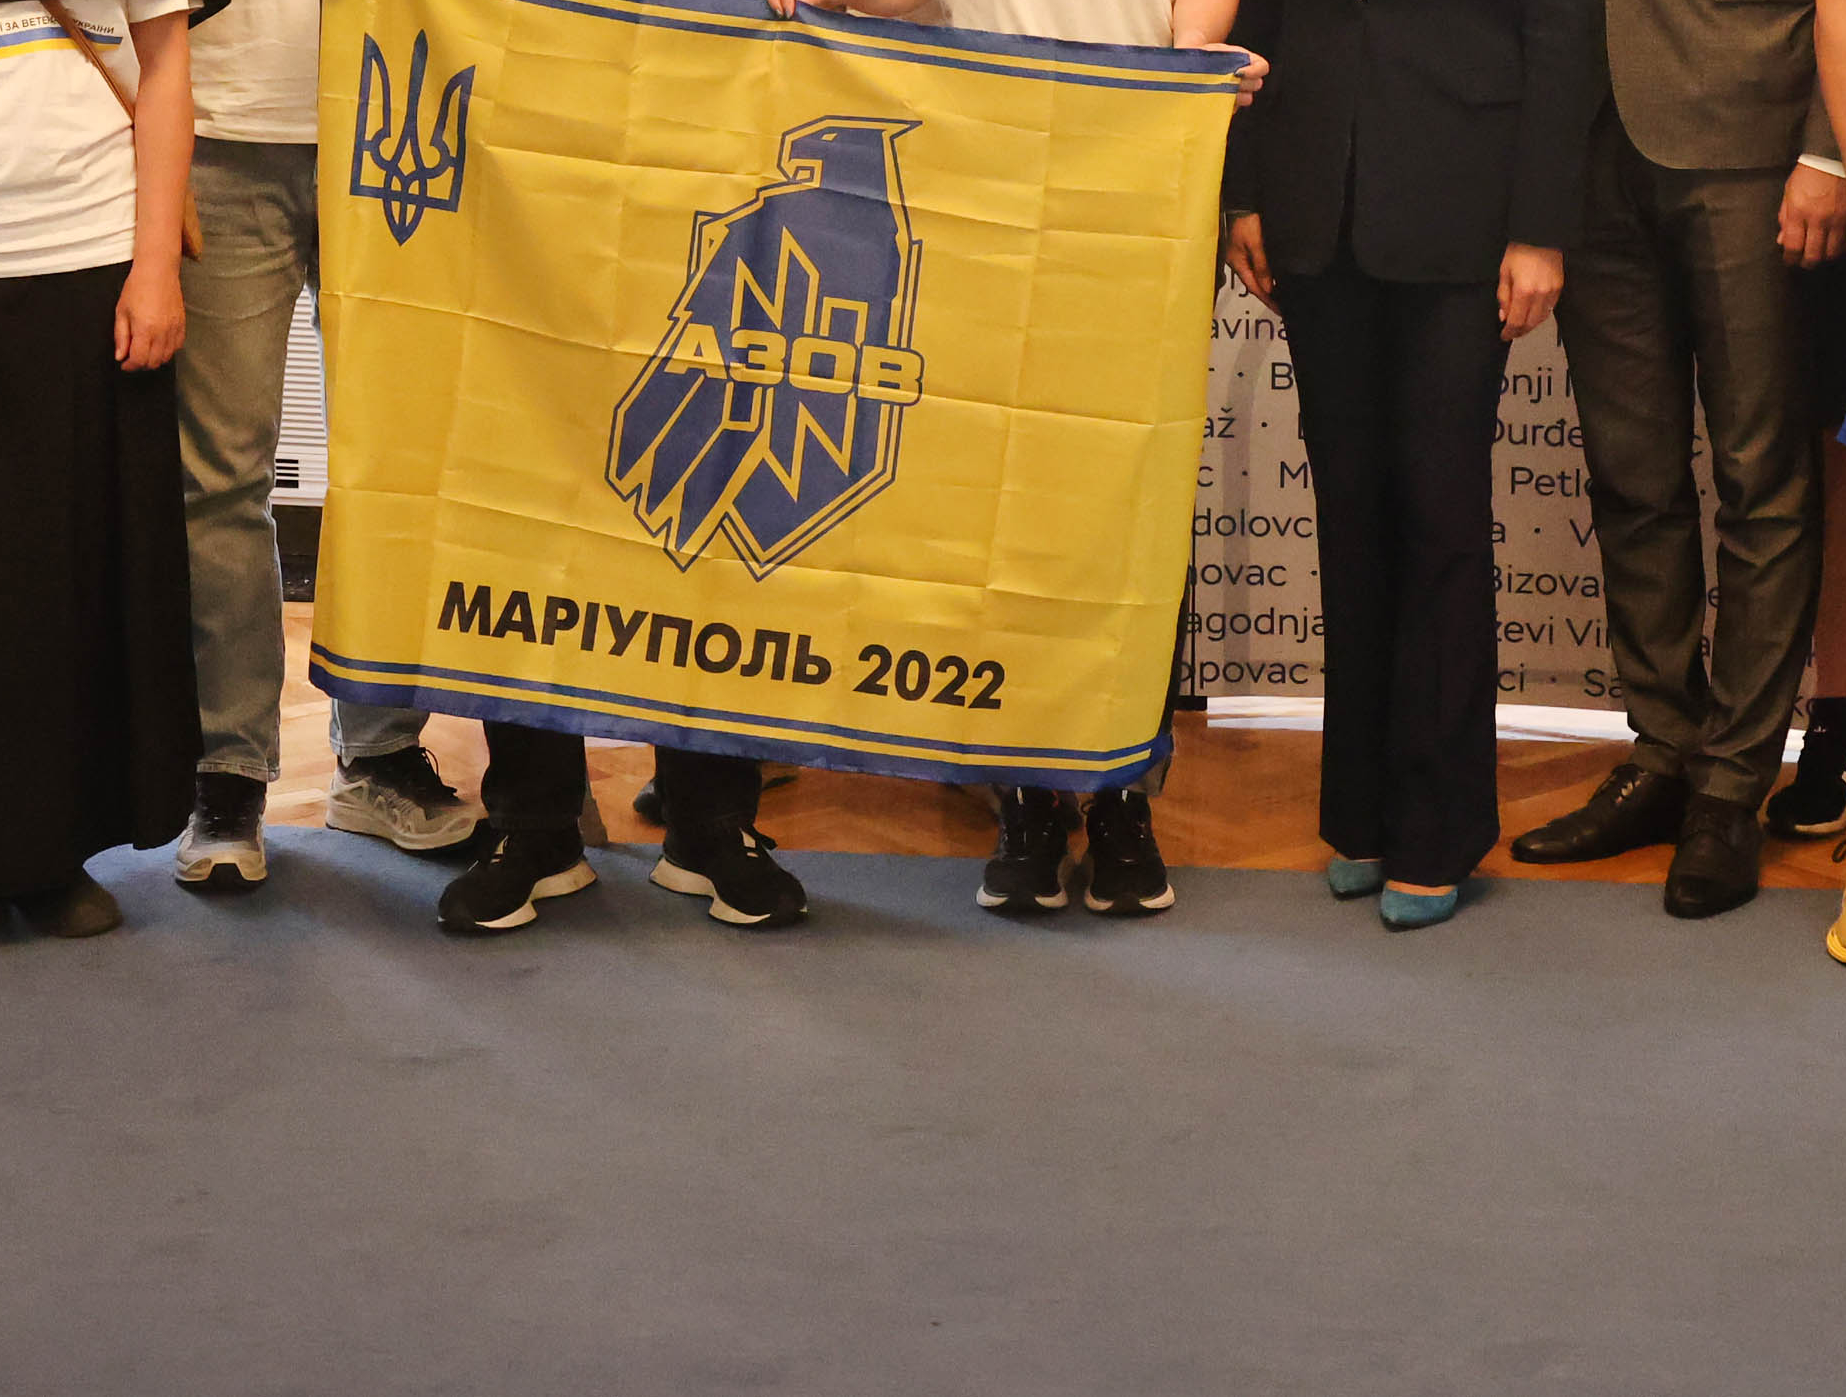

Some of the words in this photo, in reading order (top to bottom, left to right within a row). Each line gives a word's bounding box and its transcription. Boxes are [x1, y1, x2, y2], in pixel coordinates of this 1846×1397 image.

[5, 21, 20, 33] ЗА
[666, 319, 924, 406] АЗОВ
[436, 580, 833, 687] МАРІУПОЛЬ
[855, 643, 1007, 711] 2022
